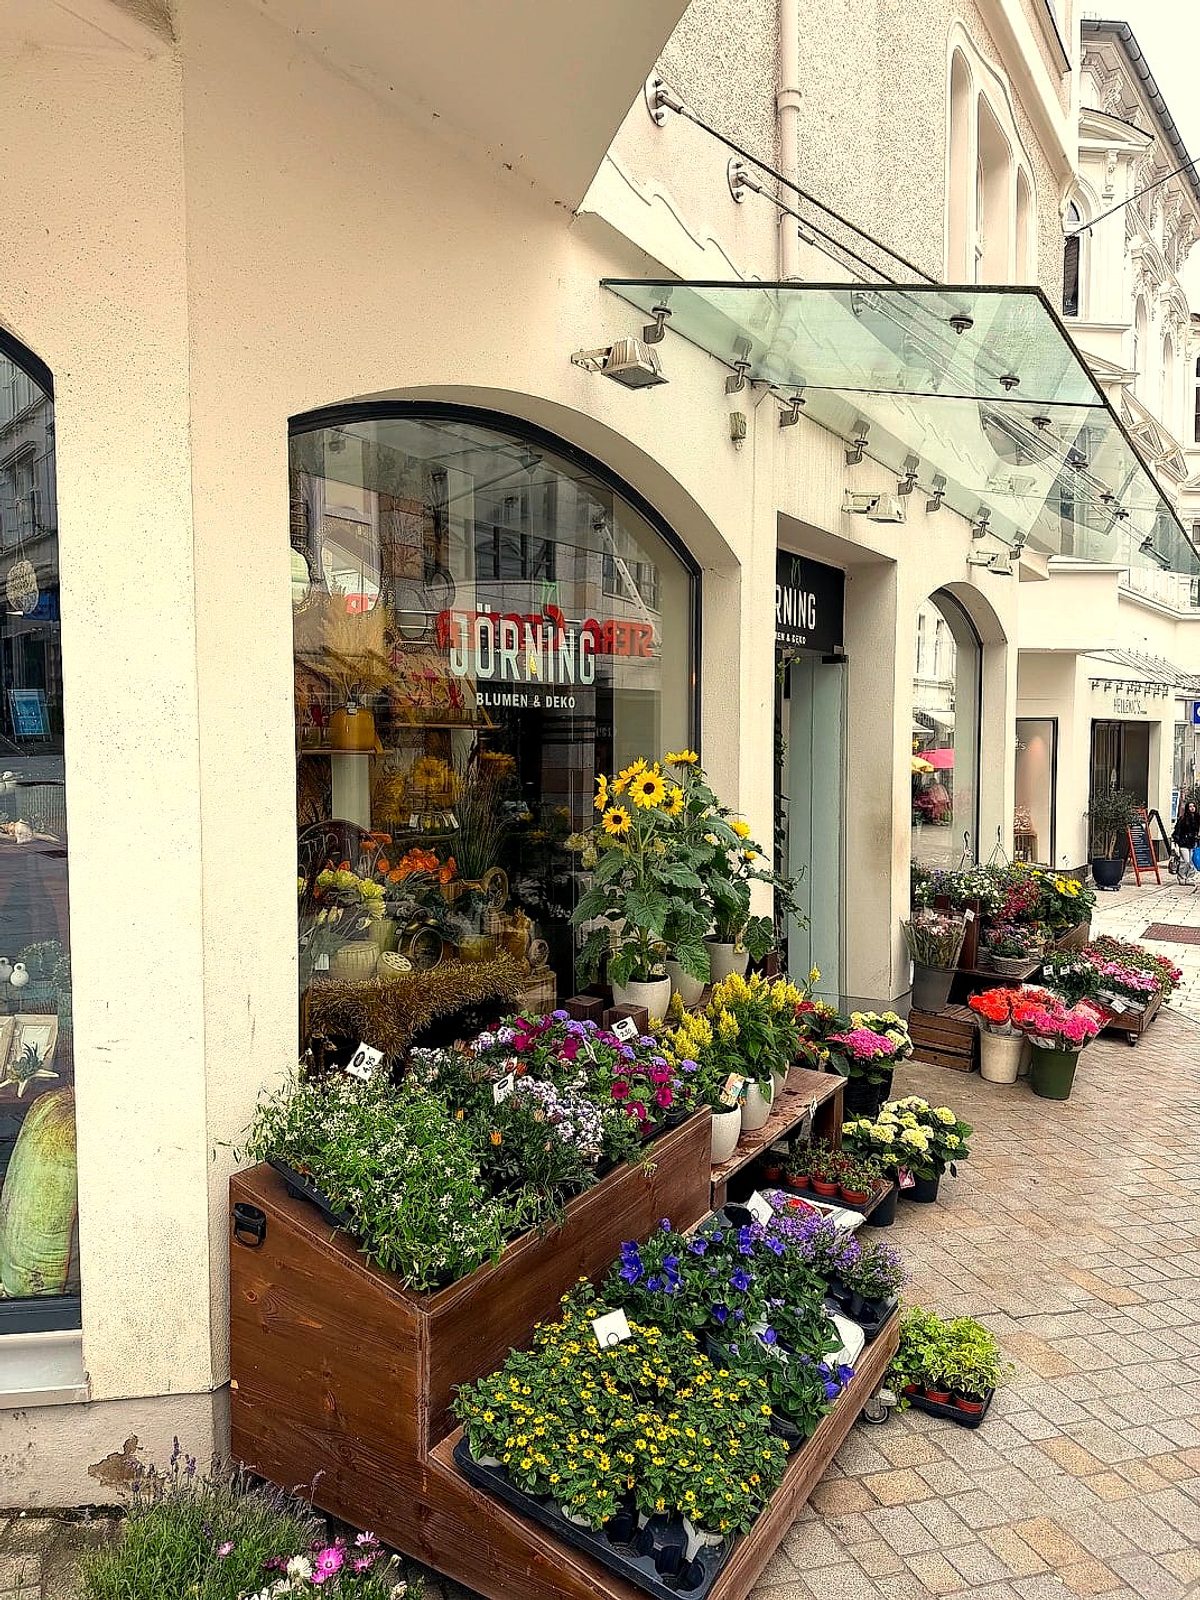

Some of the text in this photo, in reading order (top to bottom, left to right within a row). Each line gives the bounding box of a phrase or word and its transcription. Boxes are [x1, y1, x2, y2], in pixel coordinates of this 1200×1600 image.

[449, 603, 595, 685] JÖRNING
[476, 691, 576, 709] BLUMEN & DEKO
